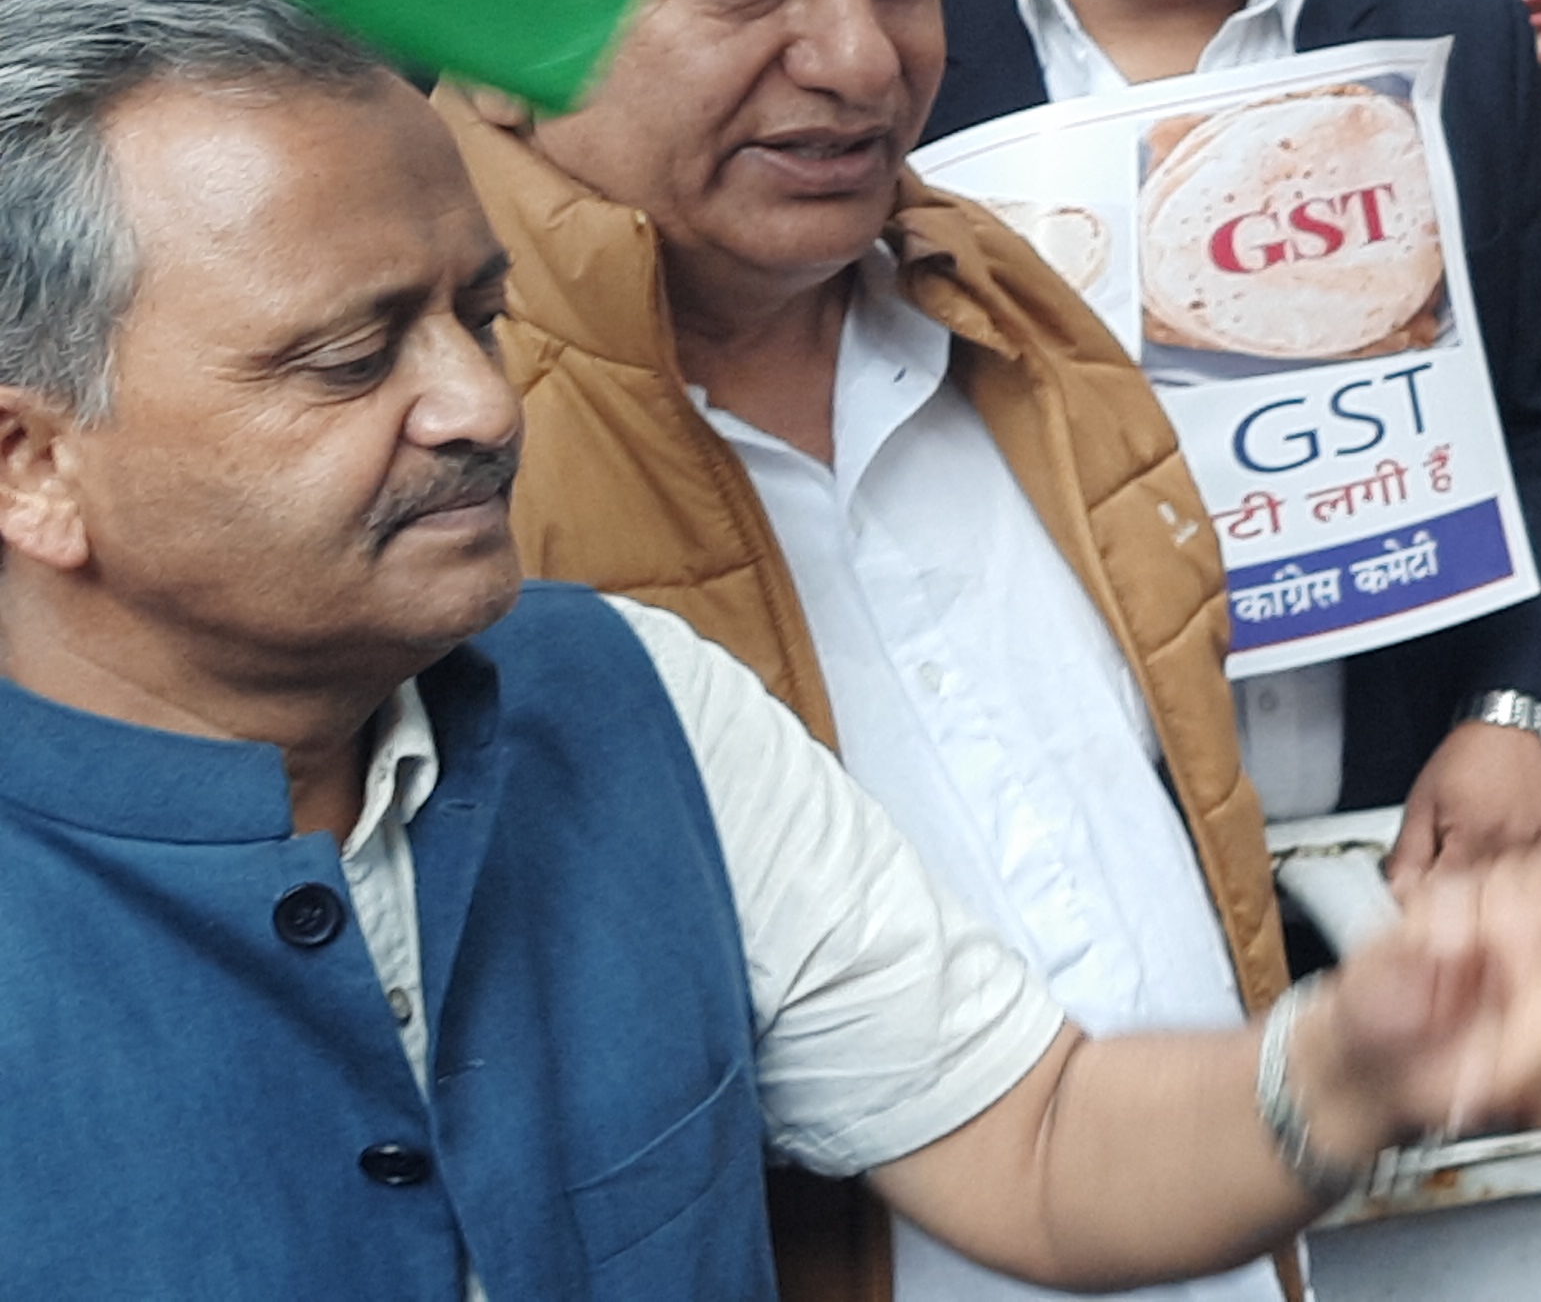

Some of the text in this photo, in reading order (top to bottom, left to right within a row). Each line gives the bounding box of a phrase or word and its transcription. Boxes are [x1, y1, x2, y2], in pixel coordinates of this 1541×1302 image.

[1208, 183, 1396, 276] GST
[1231, 362, 1434, 474] GST
[1212, 490, 1285, 539] टी
[1305, 459, 1408, 522] लगी
[1231, 530, 1439, 622] कांग्रेस कमेटी
